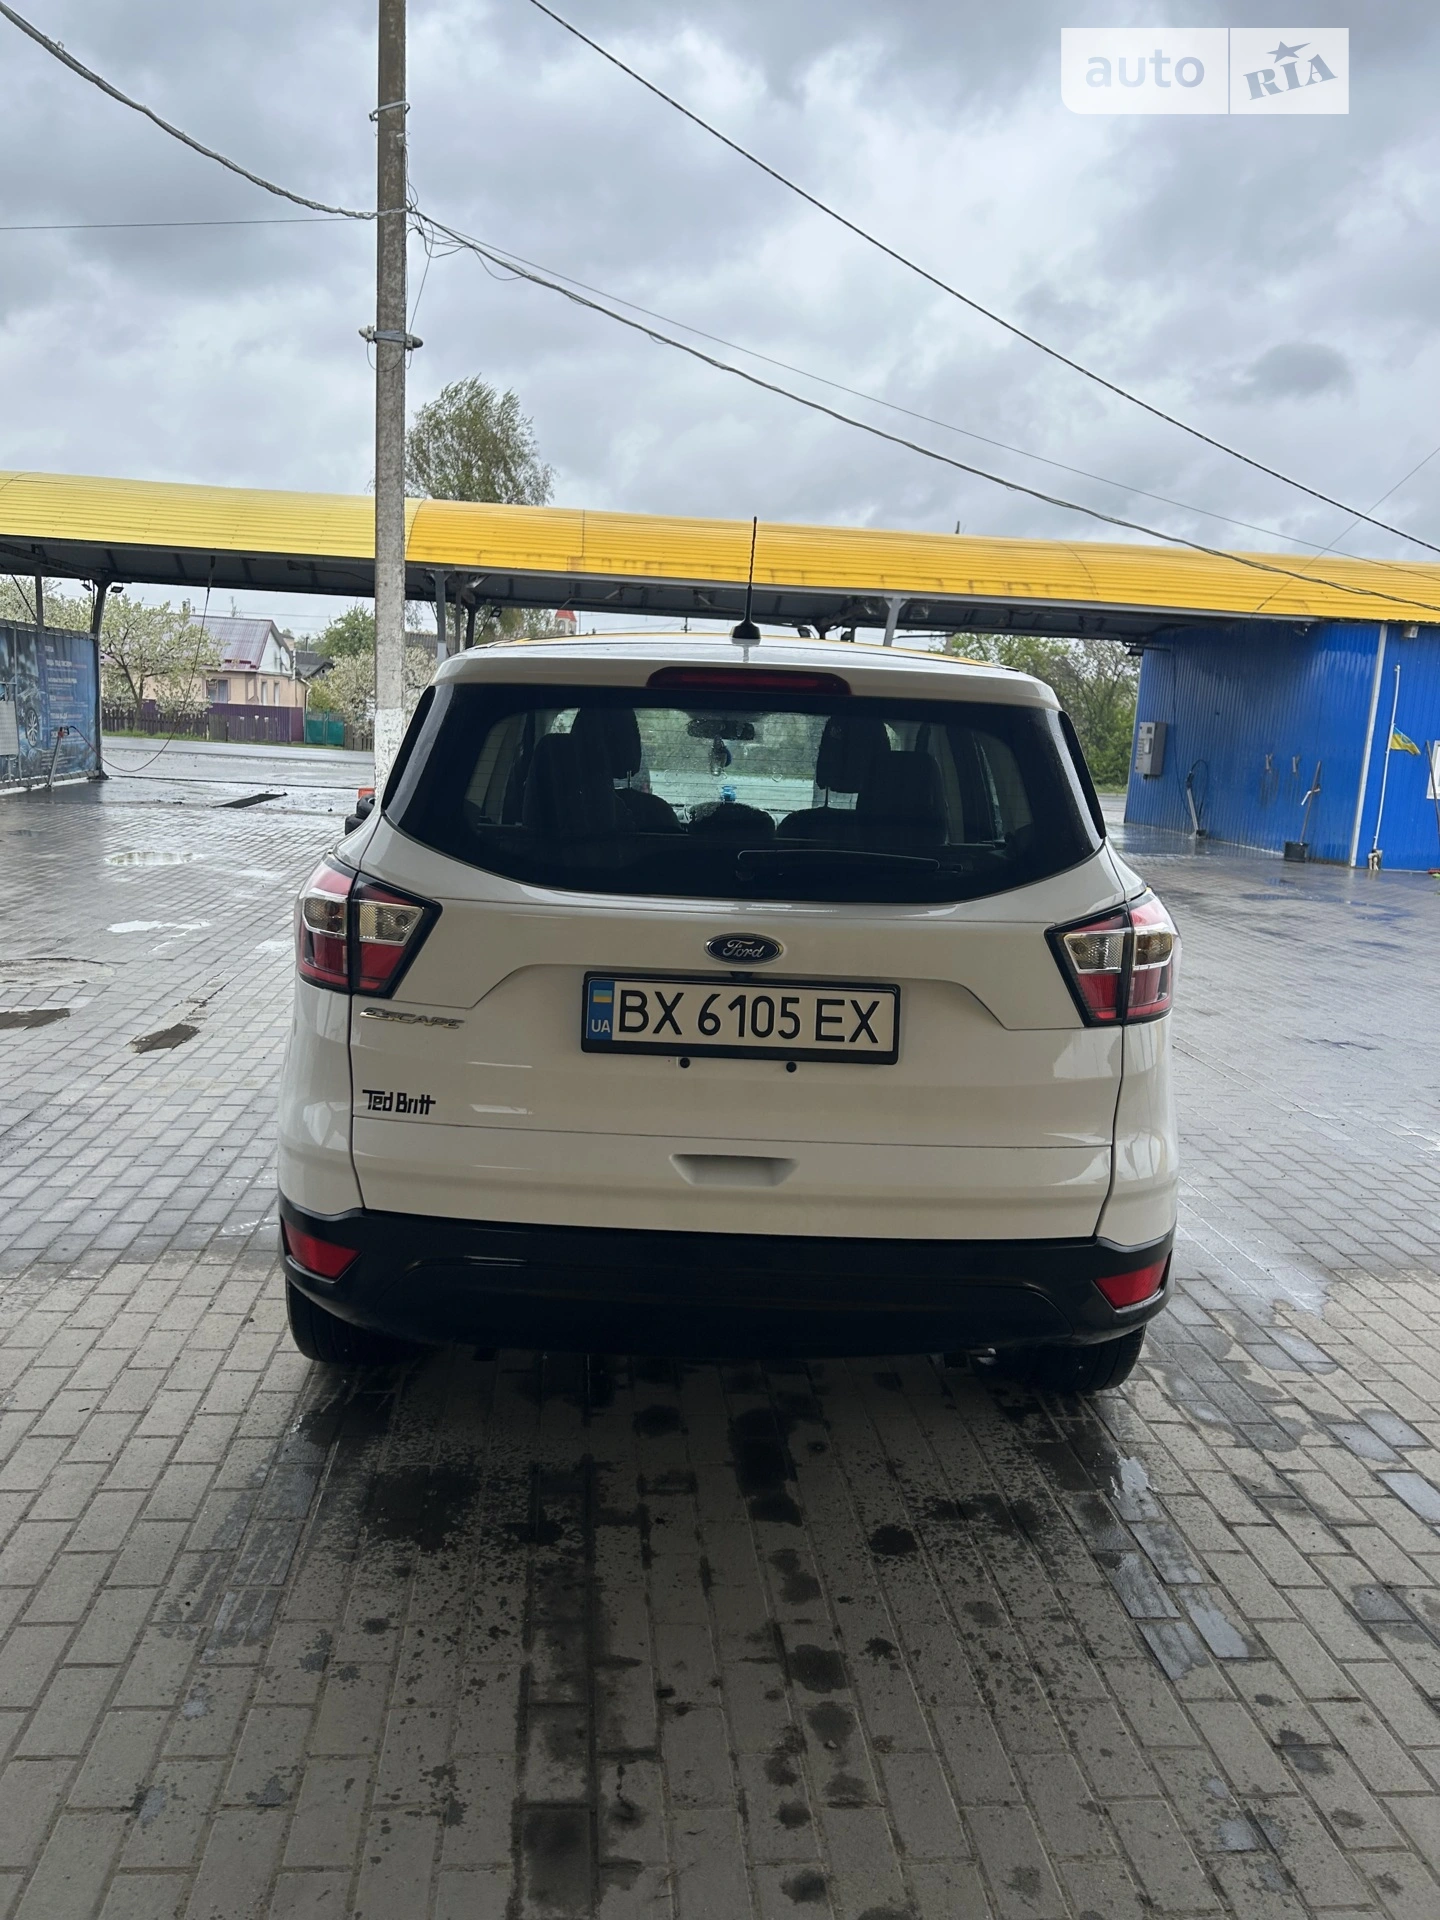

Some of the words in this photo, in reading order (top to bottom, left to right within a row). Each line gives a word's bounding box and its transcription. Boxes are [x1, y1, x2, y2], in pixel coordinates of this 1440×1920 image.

[722, 939, 765, 958] Ford
[591, 1019, 611, 1033] UA
[618, 989, 684, 1035] BX
[697, 993, 801, 1040] 6105
[815, 998, 880, 1044] EX
[362, 1089, 394, 1111] Ted
[395, 1092, 436, 1115] Britt
